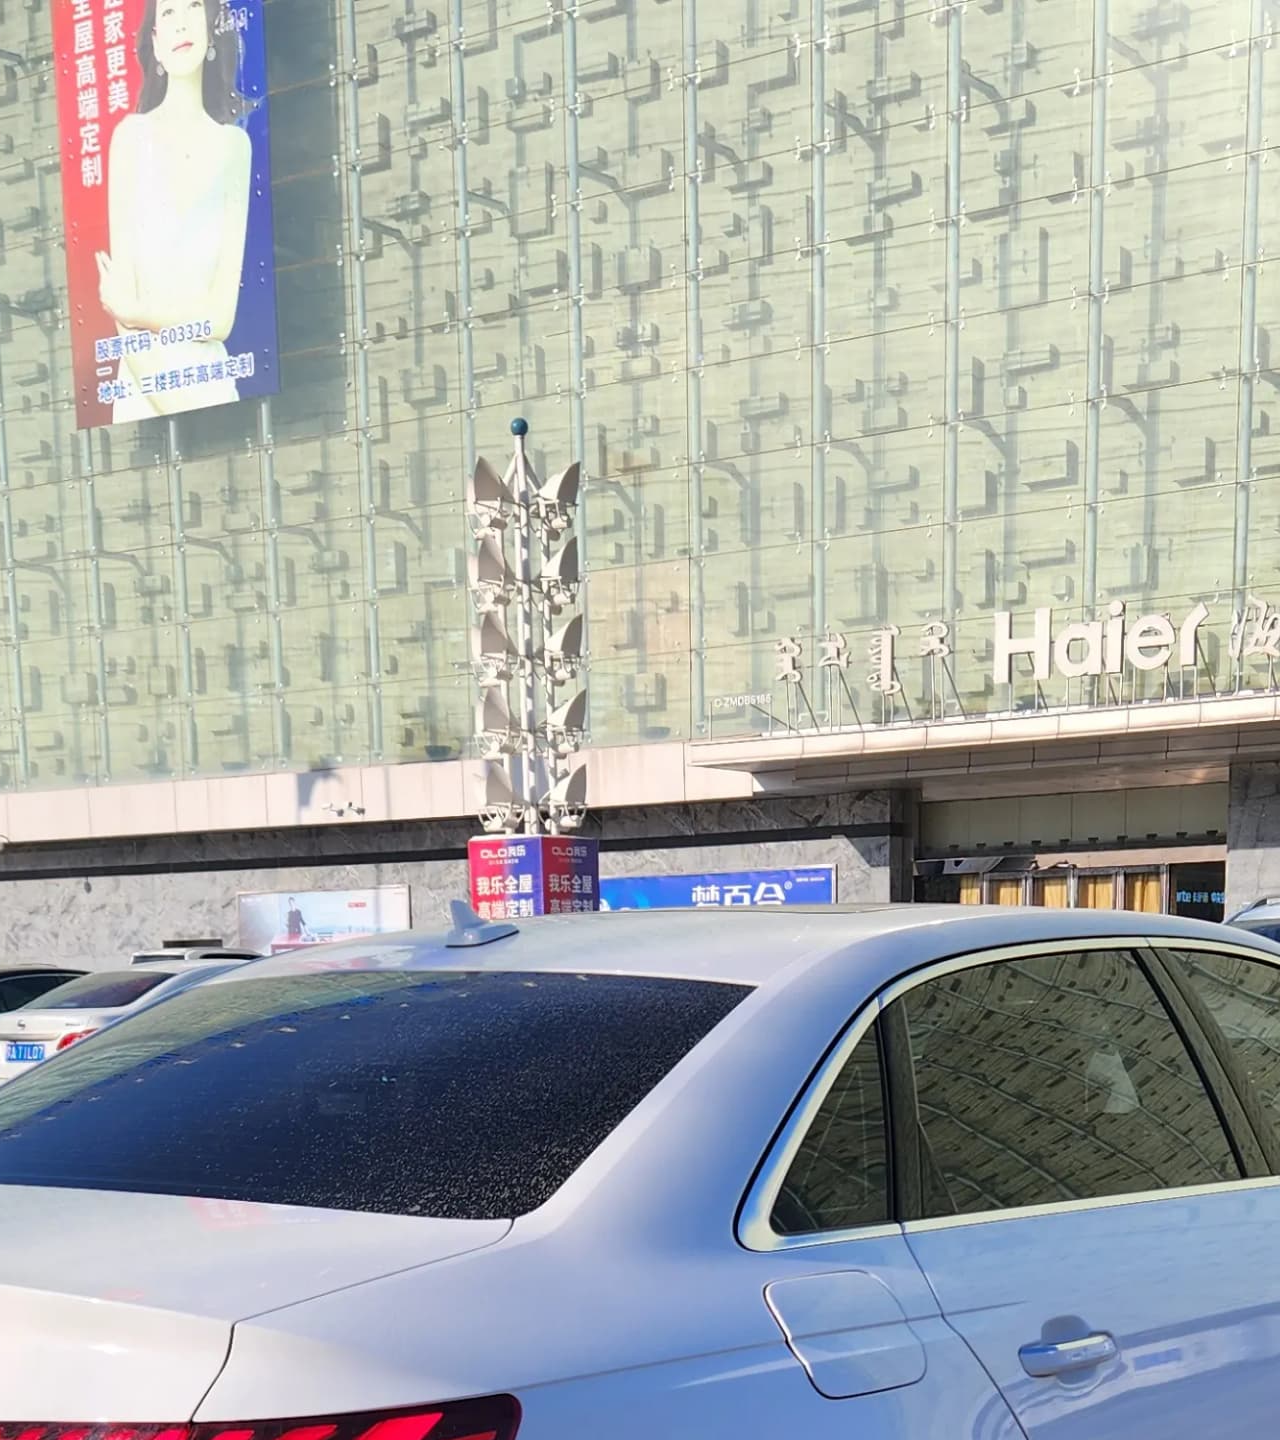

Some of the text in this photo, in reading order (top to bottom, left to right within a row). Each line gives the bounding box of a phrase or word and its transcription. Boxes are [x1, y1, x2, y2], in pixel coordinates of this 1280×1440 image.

[102, 0, 130, 114] 家更美
[993, 600, 1209, 684] Haier
[477, 874, 533, 896] 我乐全屋
[549, 874, 592, 894] 我乐全屋
[478, 899, 534, 919] 高端定制
